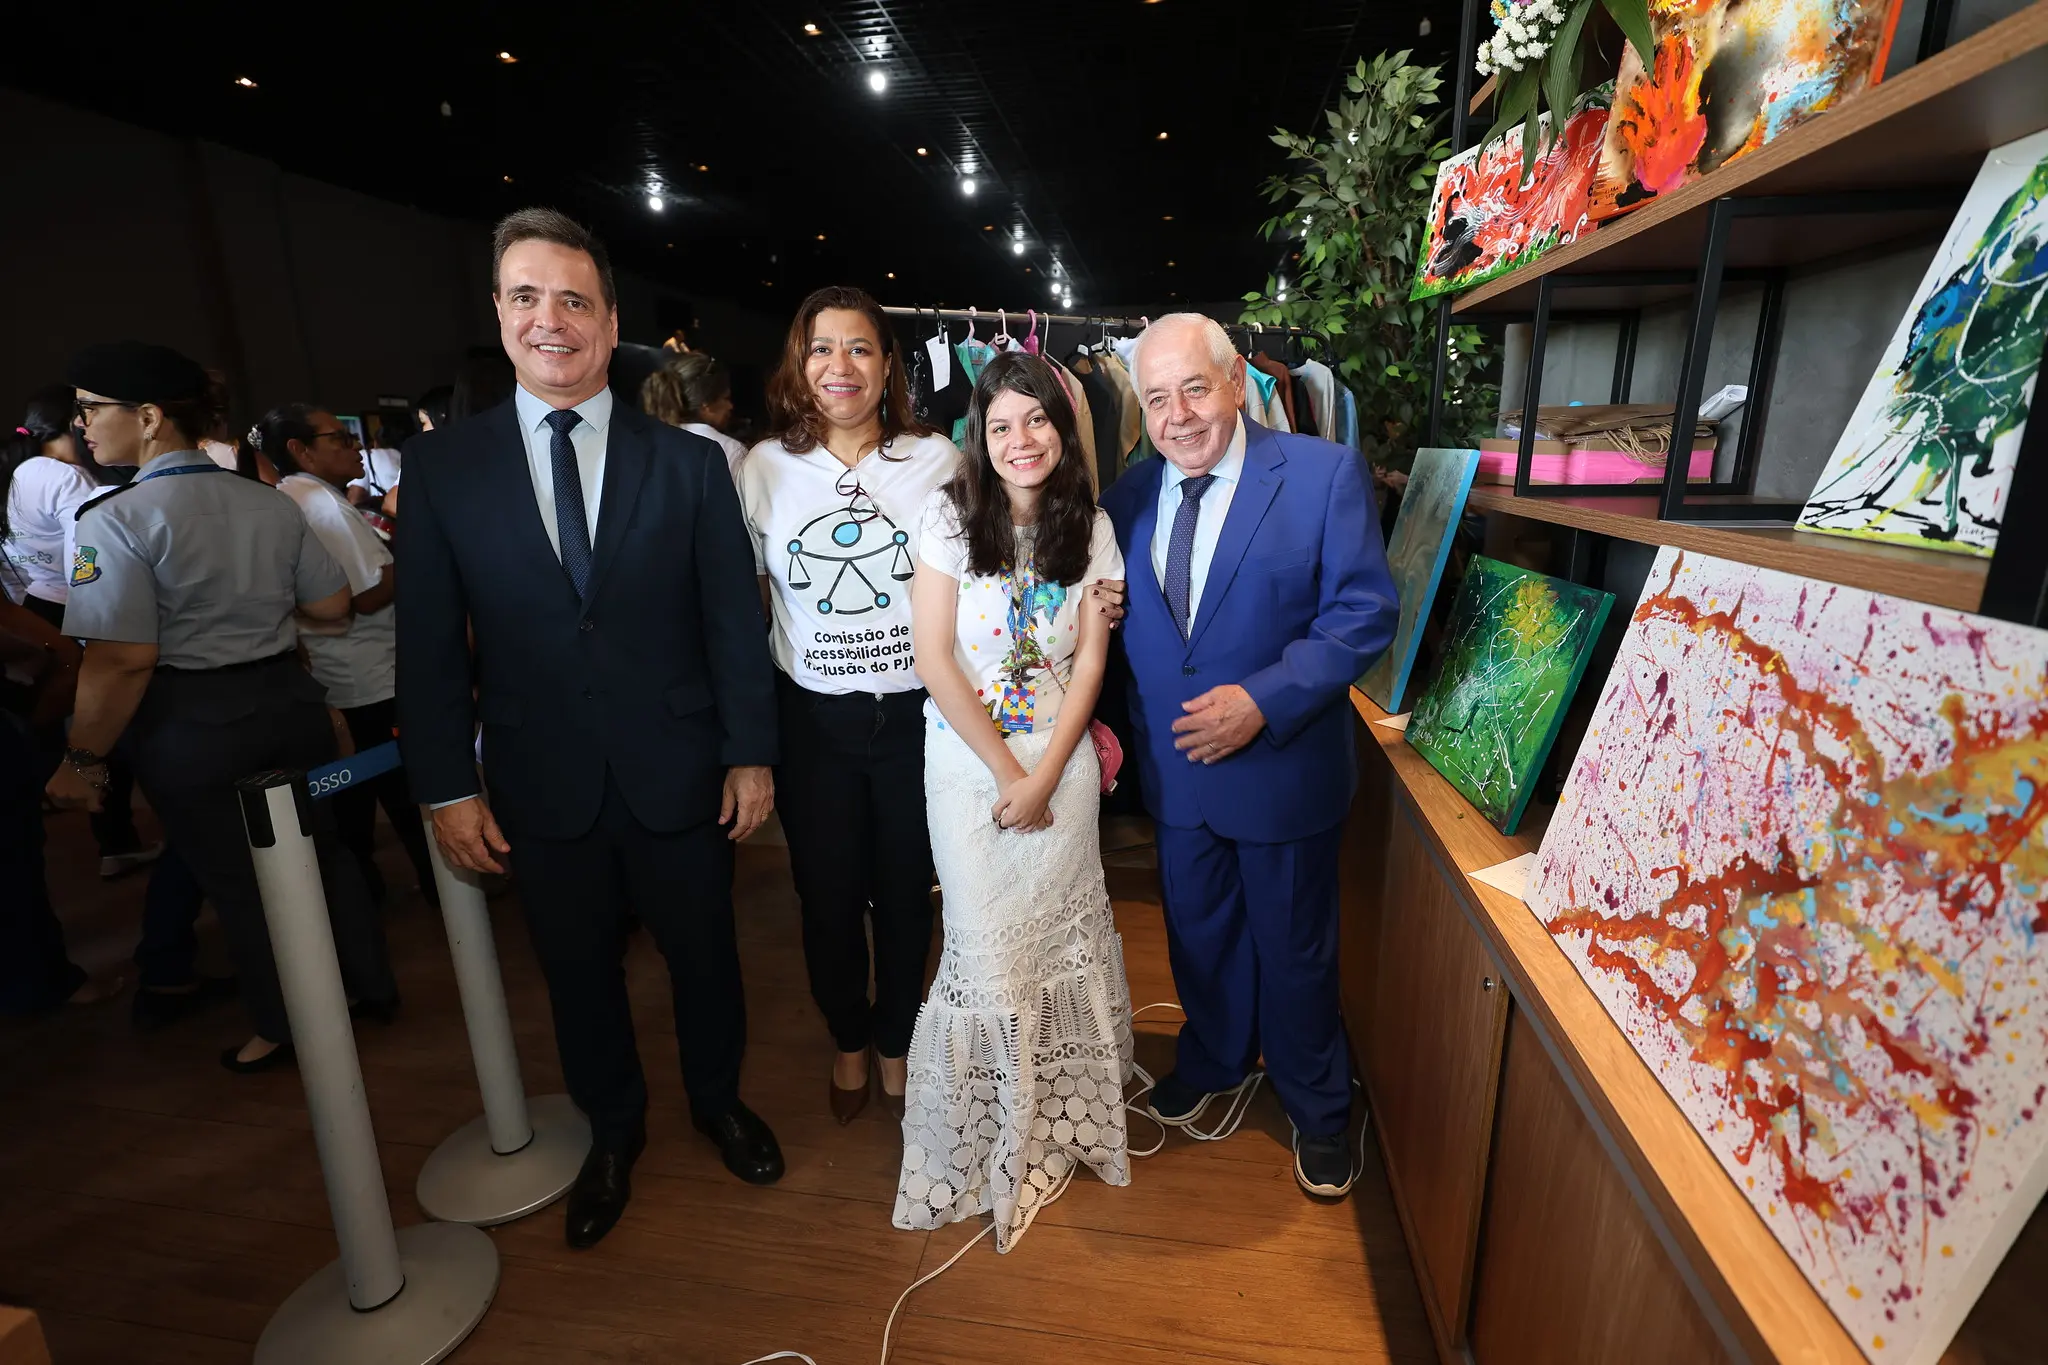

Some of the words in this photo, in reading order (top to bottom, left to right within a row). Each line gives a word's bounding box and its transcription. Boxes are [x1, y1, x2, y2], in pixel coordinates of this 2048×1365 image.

[814, 629, 885, 644] Comissão
[889, 625, 909, 638] de
[805, 641, 911, 660] Acessibilidade
[870, 661, 888, 673] do
